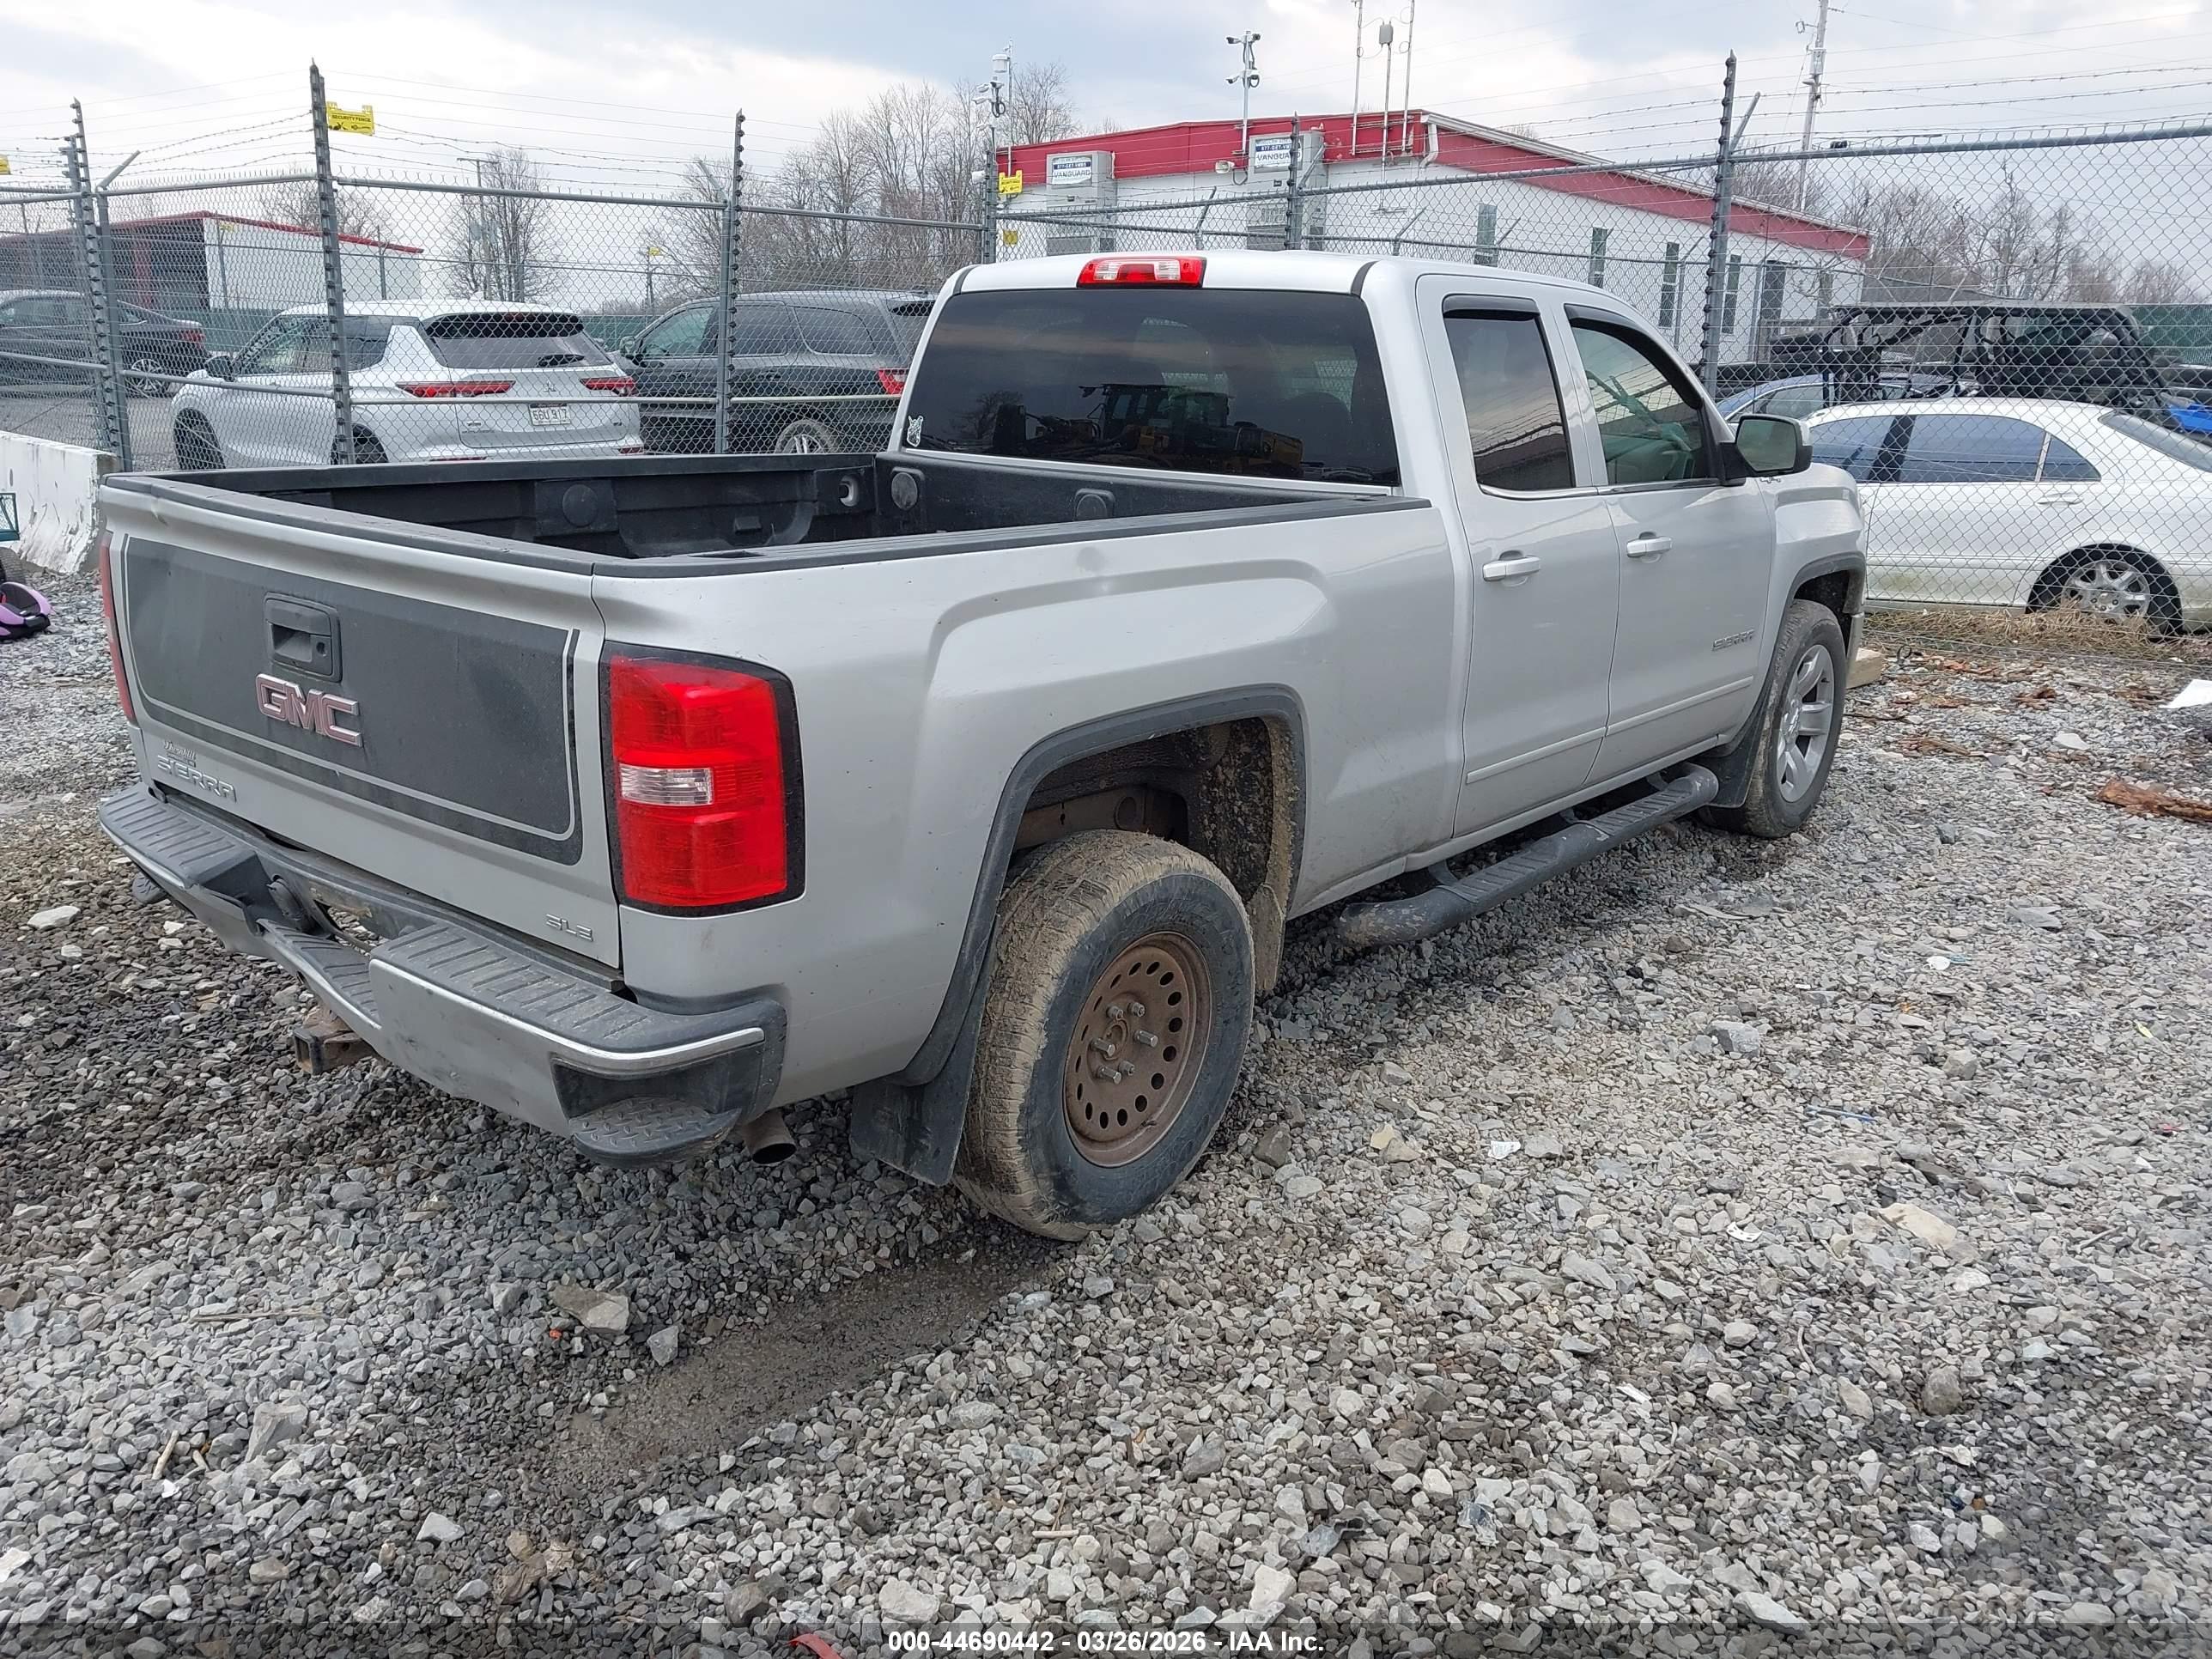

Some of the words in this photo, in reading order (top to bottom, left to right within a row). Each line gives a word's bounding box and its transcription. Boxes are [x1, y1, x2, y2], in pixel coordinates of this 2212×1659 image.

[1257, 152, 1301, 161] VANGUAD
[1054, 169, 1091, 179] VANGUARD
[256, 672, 363, 748] GMC
[156, 754, 238, 803] SIERRA
[544, 913, 594, 942] SLE
